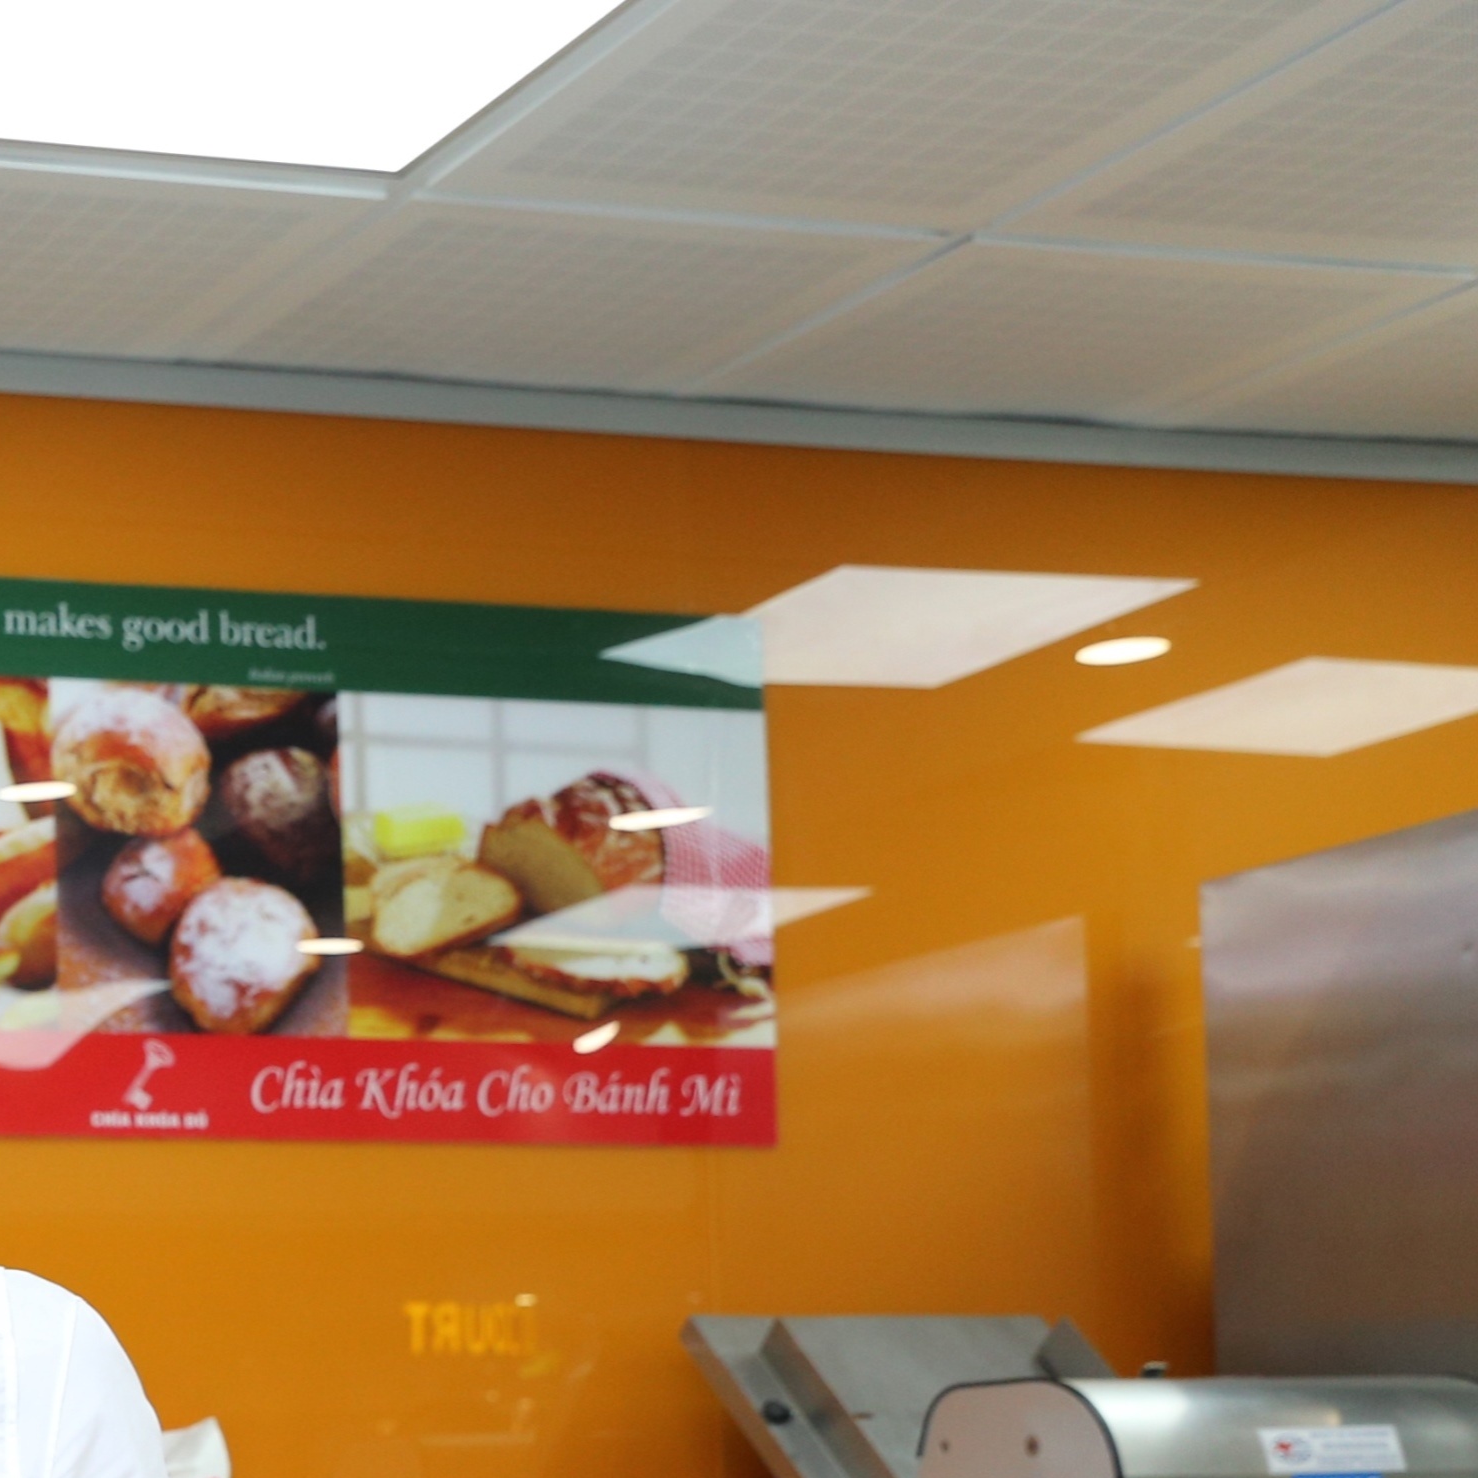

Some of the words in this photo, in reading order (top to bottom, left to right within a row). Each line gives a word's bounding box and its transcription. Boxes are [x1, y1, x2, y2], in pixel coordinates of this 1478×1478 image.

[3, 601, 113, 640] makes
[121, 609, 210, 652] good
[219, 609, 328, 650] bread.
[249, 1059, 345, 1114] Chìa
[354, 1062, 467, 1120] Khóa
[476, 1064, 556, 1118] Cho
[562, 1066, 672, 1115] Bánh
[679, 1072, 742, 1117] Mì
